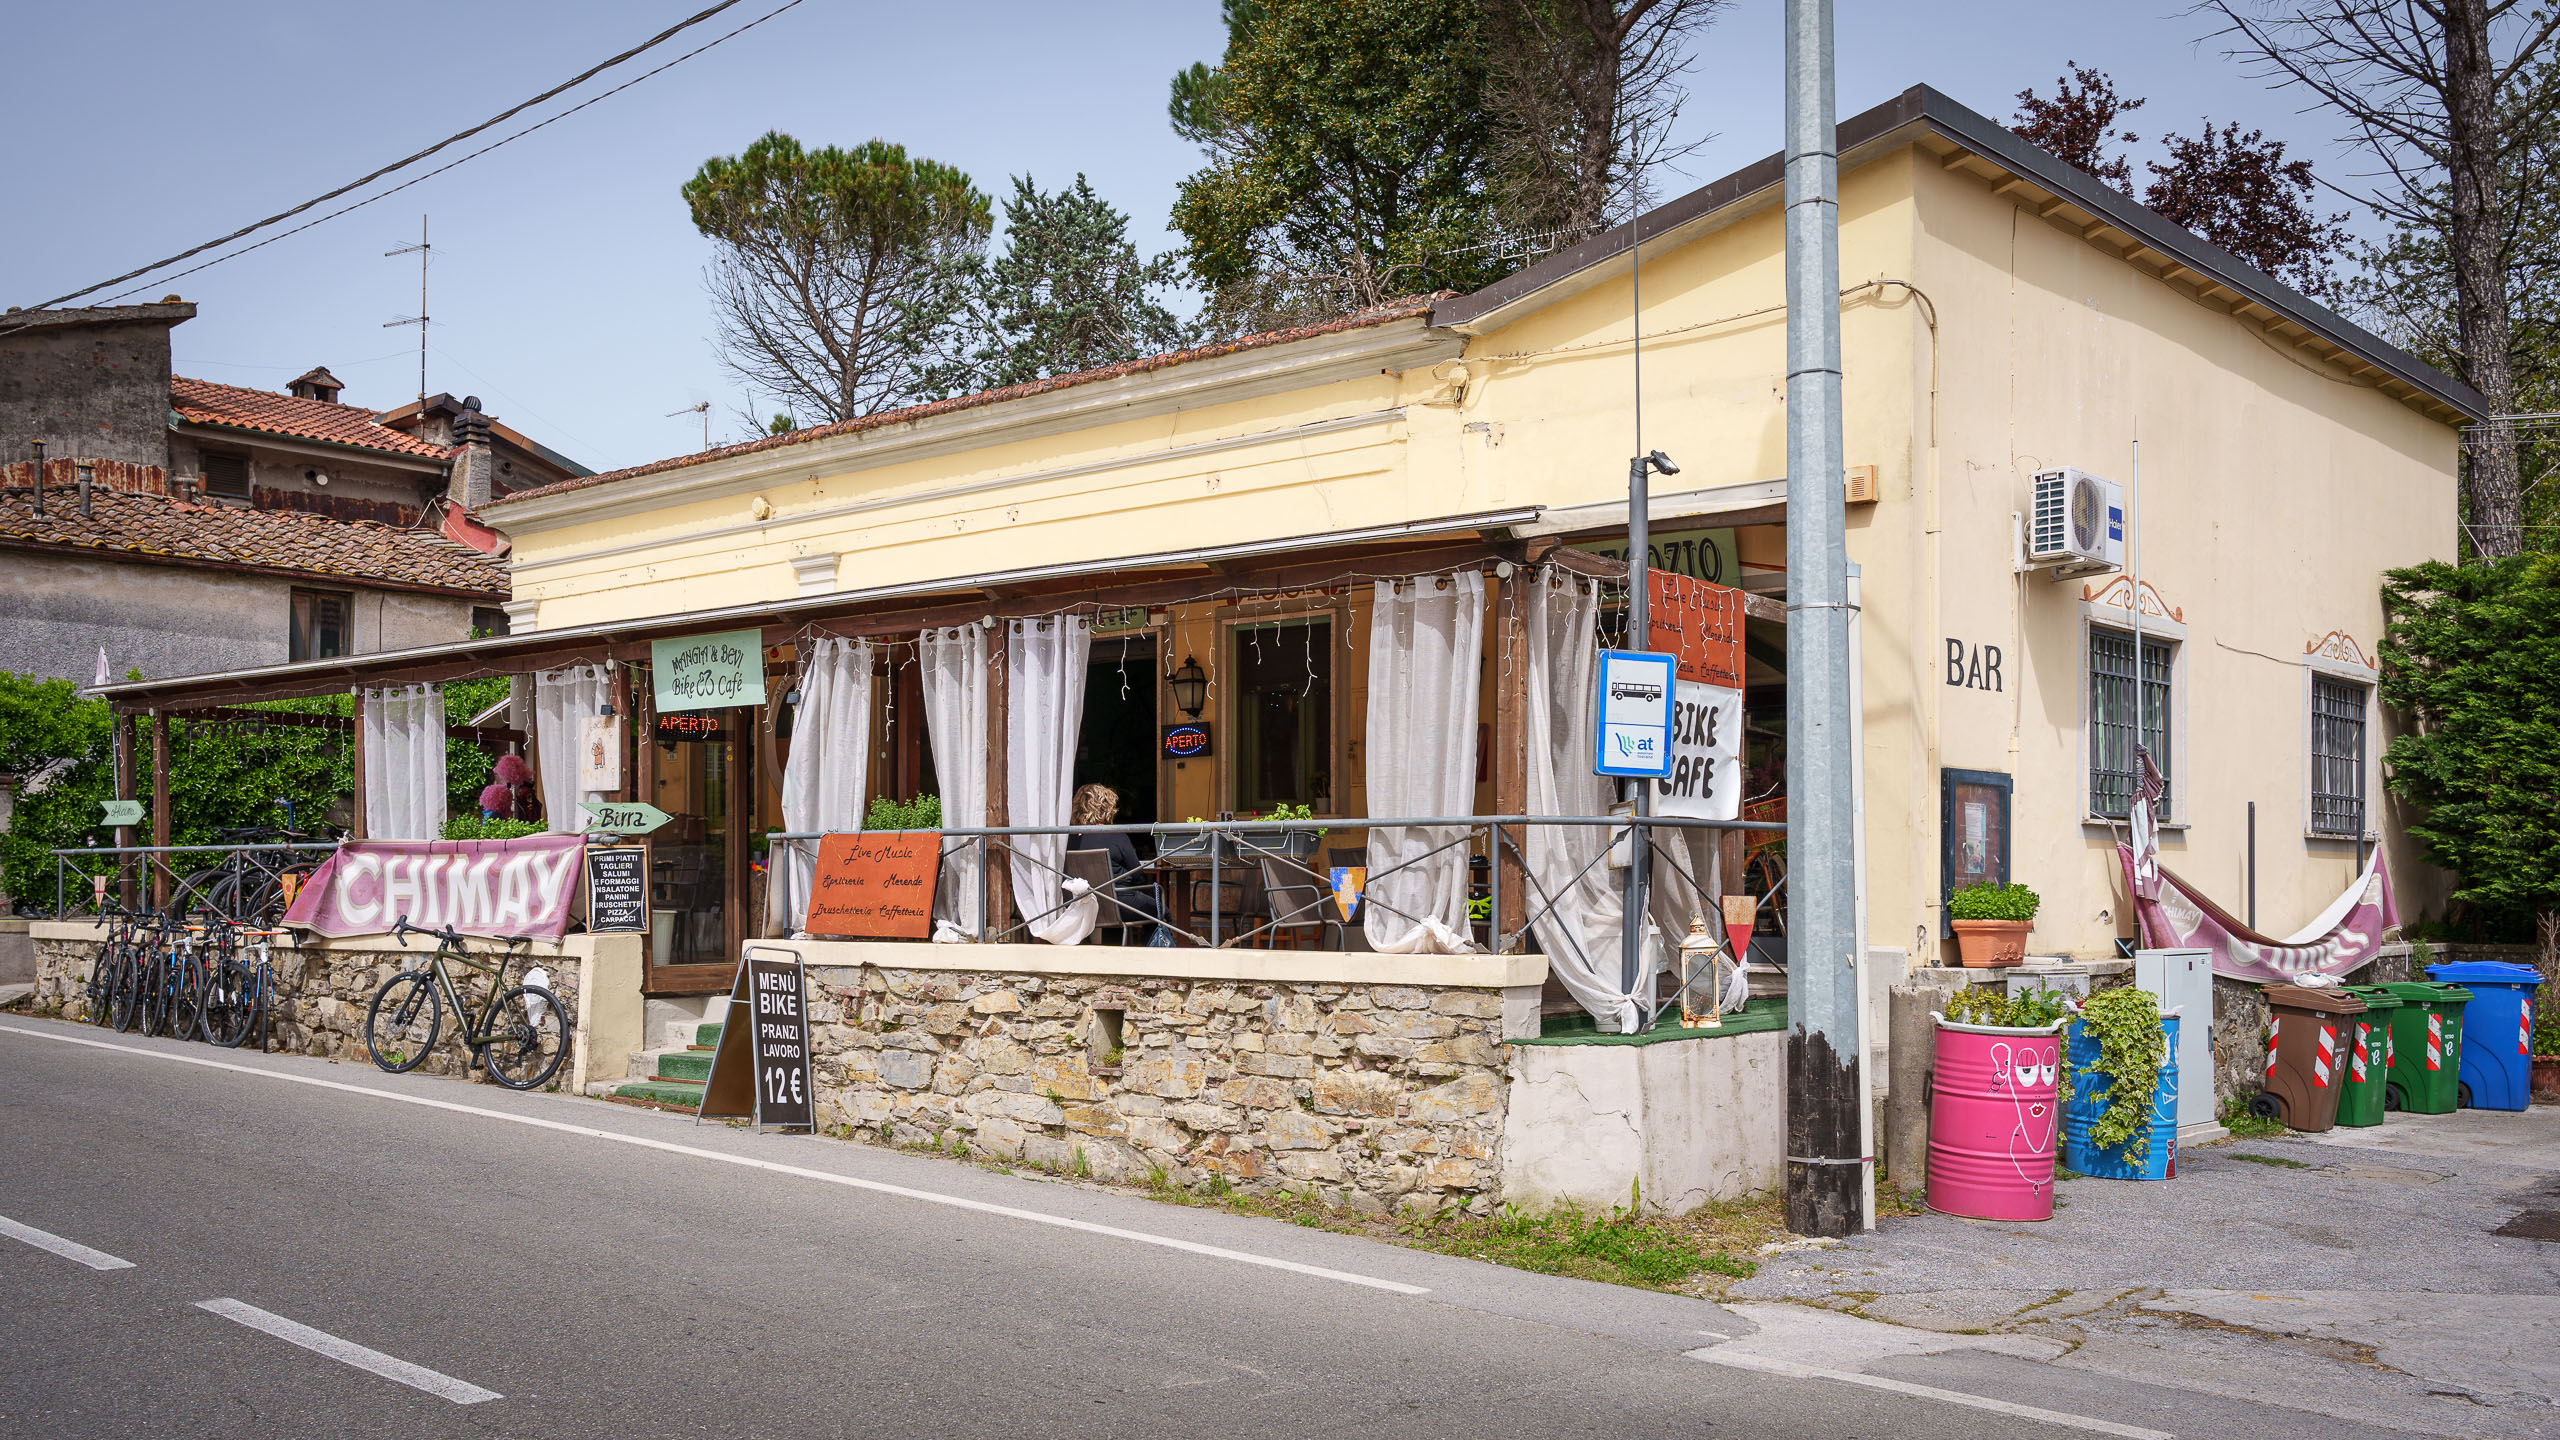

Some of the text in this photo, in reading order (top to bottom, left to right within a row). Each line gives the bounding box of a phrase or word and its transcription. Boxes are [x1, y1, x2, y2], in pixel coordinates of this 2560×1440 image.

[711, 645, 719, 663] &
[1946, 637, 2003, 692] BAR
[672, 671, 743, 699] Bike Café
[660, 716, 718, 731] APERTO
[1673, 701, 1720, 747] BIKE
[1165, 733, 1207, 748] APERTO
[1637, 737, 1654, 751] at
[599, 808, 647, 827] Birra
[615, 854, 638, 862] PIATTI
[844, 844, 913, 866] Live Music
[600, 862, 633, 870] TAGLIERI
[602, 870, 631, 878] SALUMI
[336, 843, 580, 927] CHIMAY
[596, 885, 640, 893] NSALATONE
[600, 878, 640, 886] FORMAGGI
[883, 873, 923, 889] Merende
[604, 893, 629, 901] PANINI
[600, 915, 636, 923] CARPACCI
[811, 903, 924, 921] Bruschetteria Caffetteria
[759, 970, 796, 992] MENÙ
[760, 992, 797, 1016] BIKE
[761, 1023, 799, 1040] PRANZI
[763, 1043, 800, 1058] LAVORO
